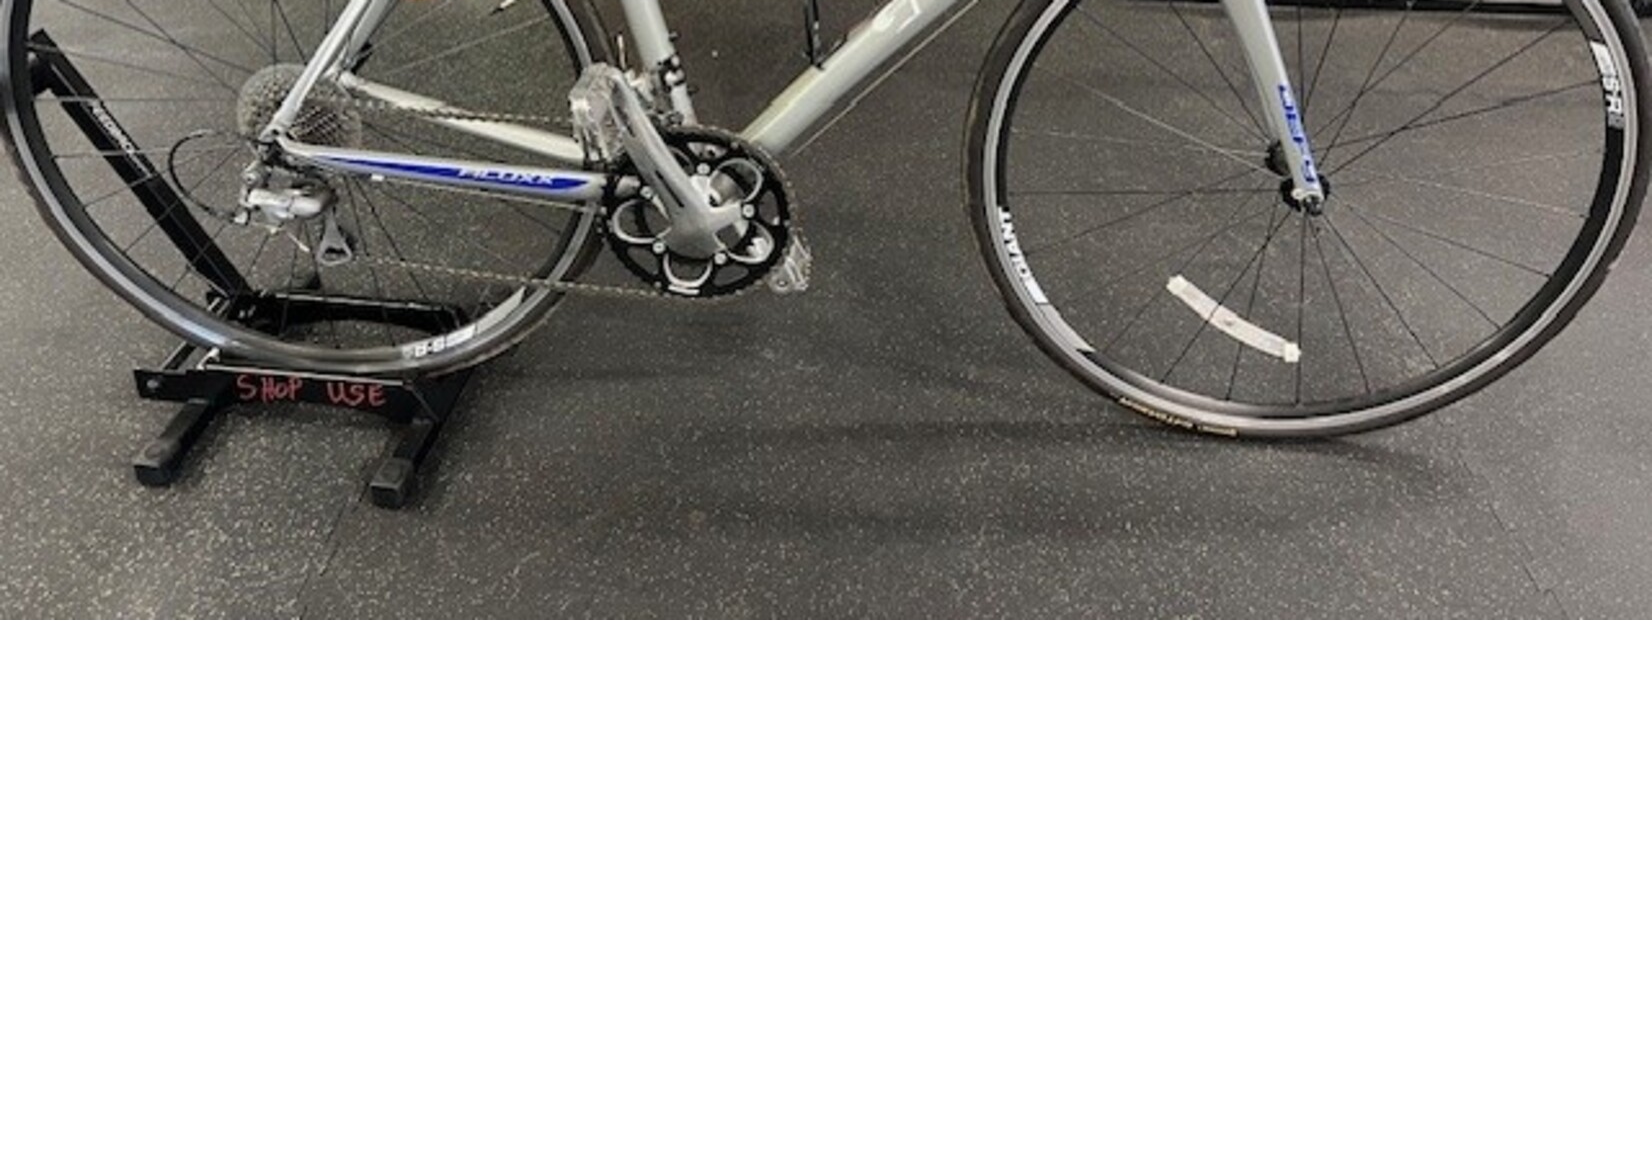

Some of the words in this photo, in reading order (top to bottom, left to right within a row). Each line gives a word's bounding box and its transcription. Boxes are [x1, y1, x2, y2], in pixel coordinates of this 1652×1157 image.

[998, 206, 1032, 280] GIANT
[236, 373, 303, 405] SHOP
[327, 381, 386, 406] USE
